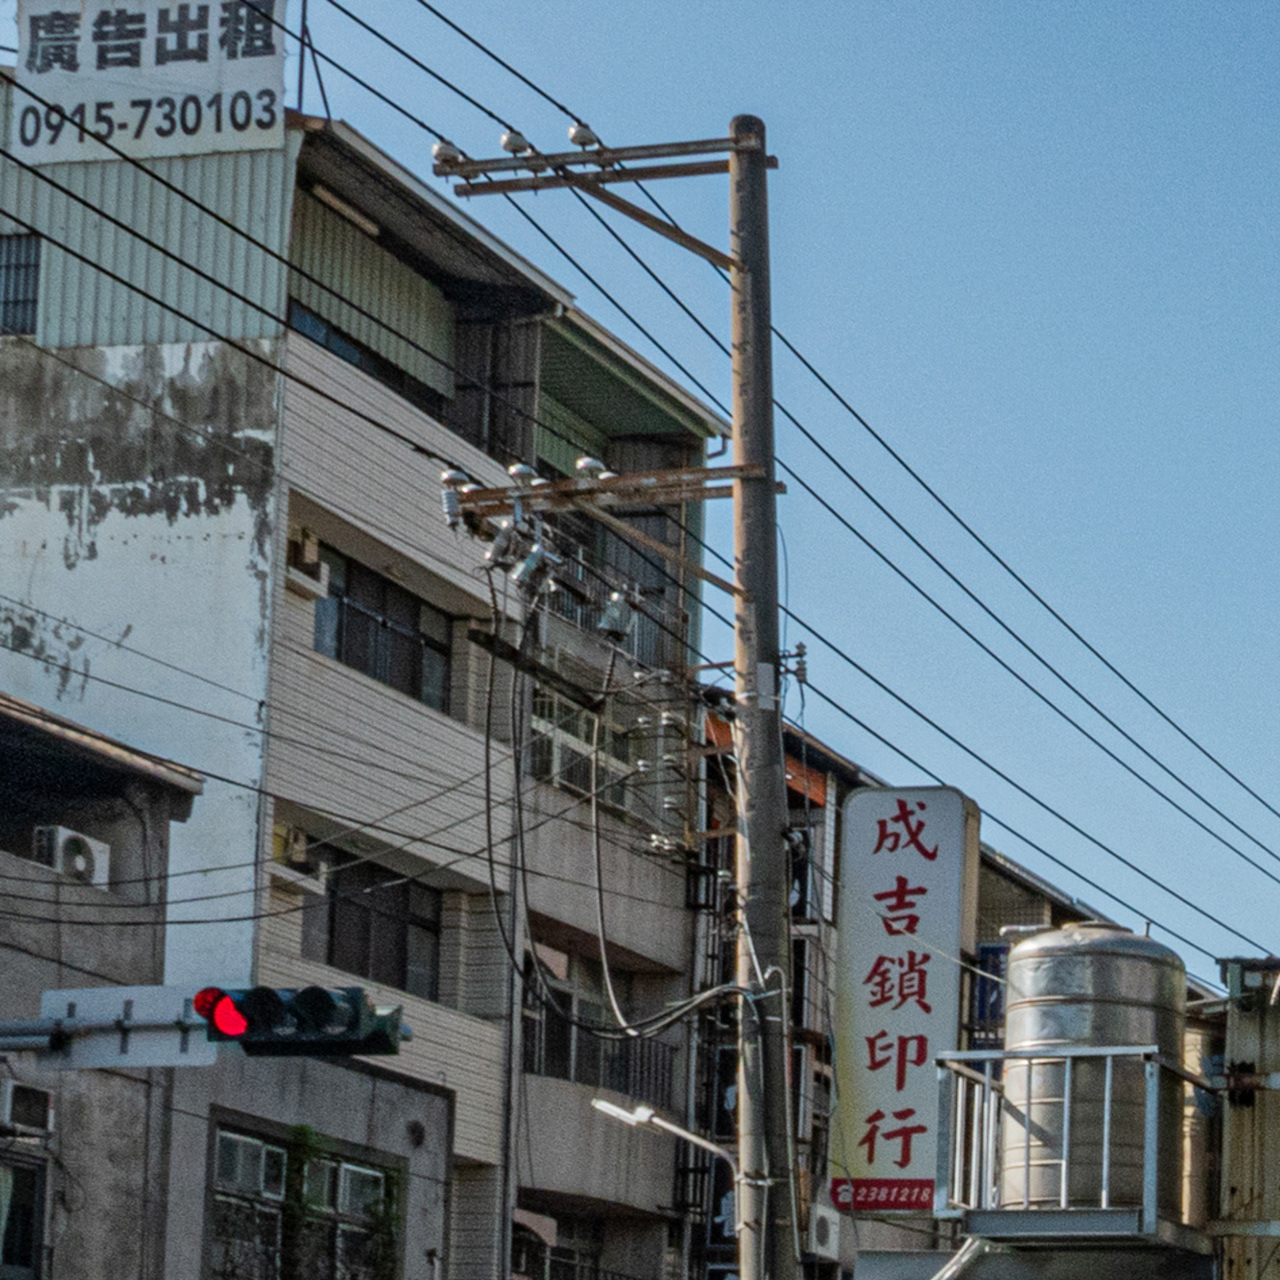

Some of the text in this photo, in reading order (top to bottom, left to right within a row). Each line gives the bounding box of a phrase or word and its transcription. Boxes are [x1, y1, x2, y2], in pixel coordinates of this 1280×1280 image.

[26, 0, 277, 74] 廣告出租
[19, 88, 277, 147] 0915-730103
[858, 799, 938, 1168] 成吉鎖印行
[856, 1186, 931, 1202] 2381218
